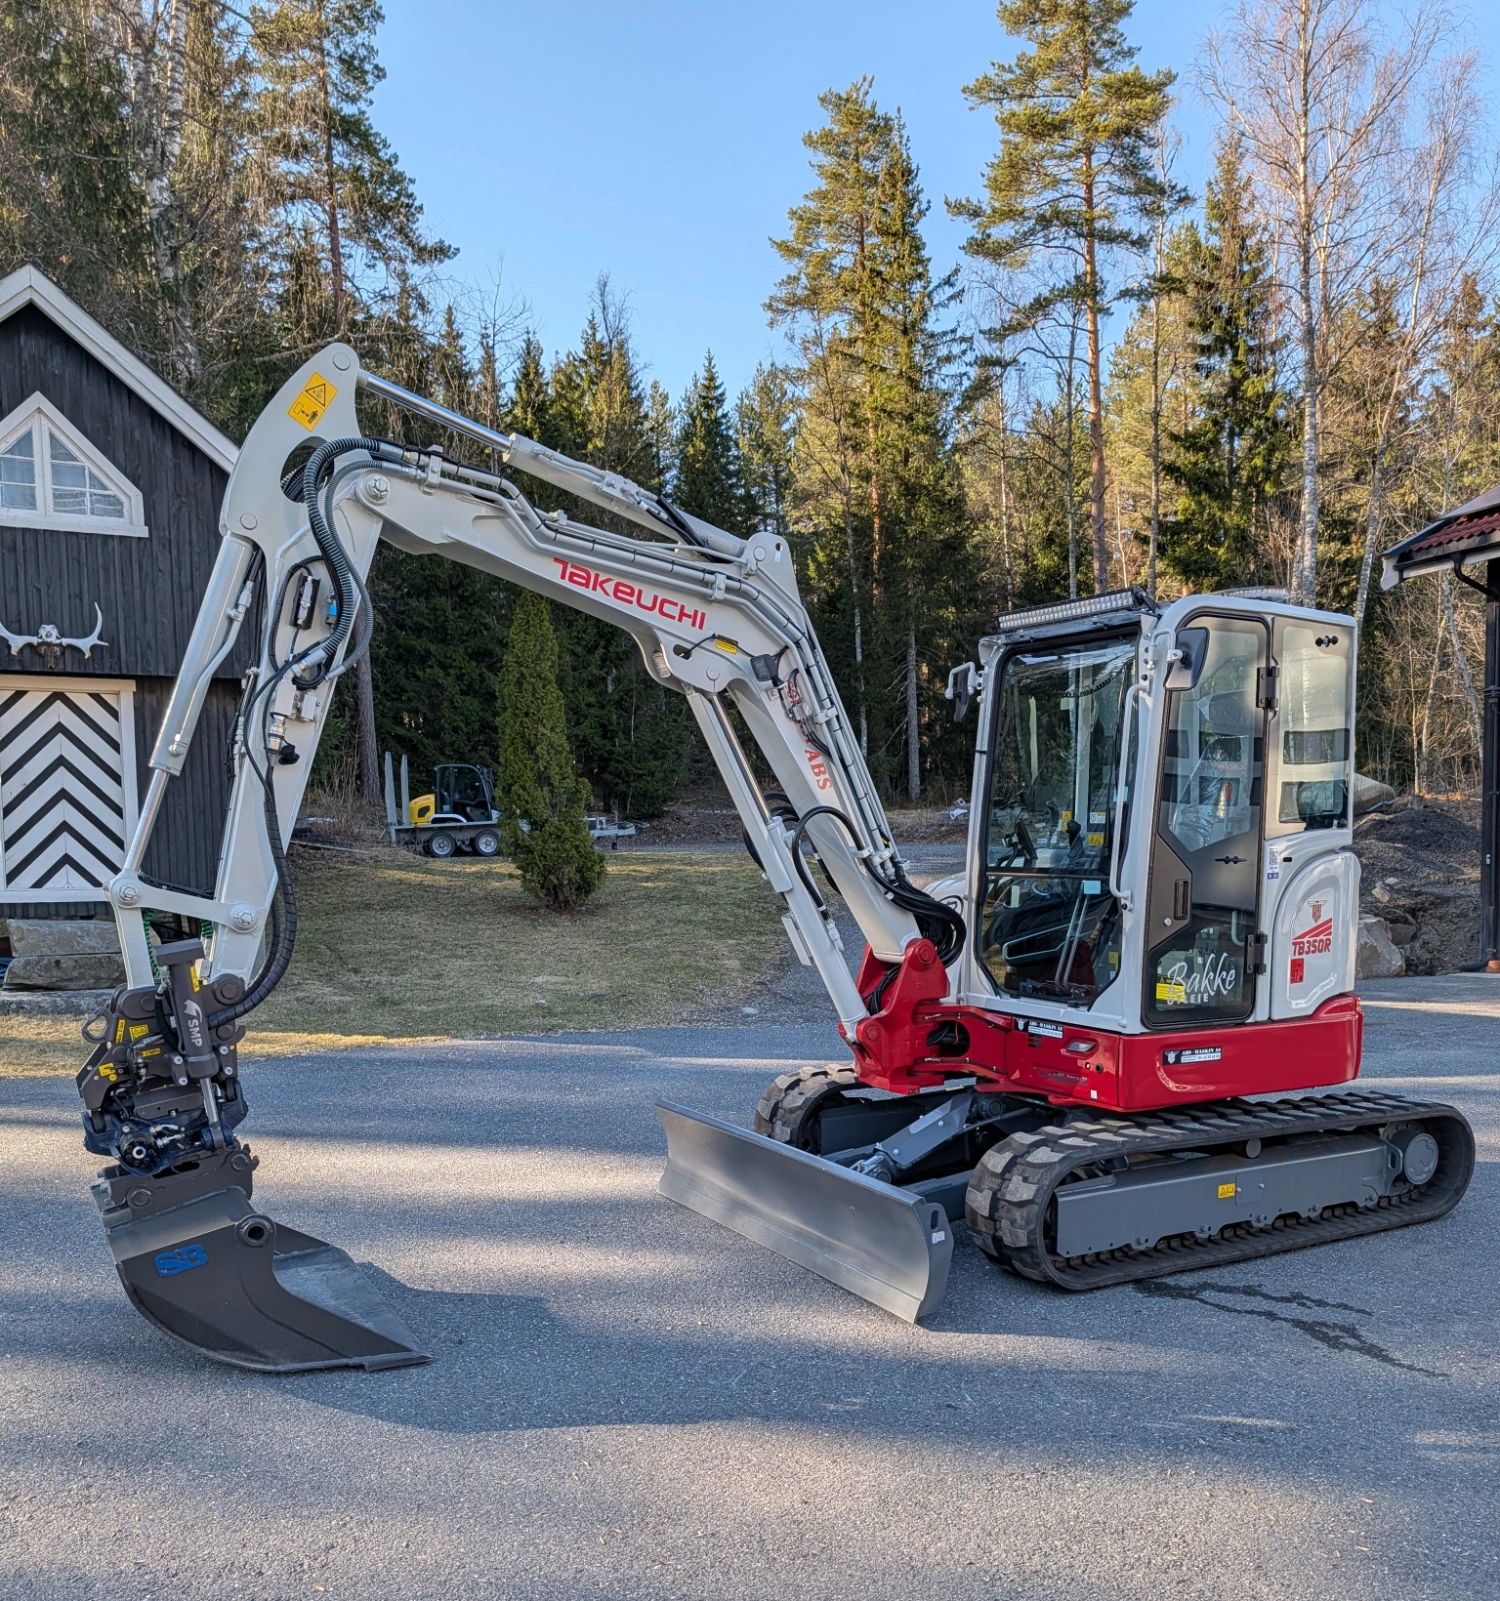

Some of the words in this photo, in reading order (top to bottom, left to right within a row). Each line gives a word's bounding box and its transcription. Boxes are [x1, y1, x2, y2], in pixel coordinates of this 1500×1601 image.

[804, 749, 833, 791] ABS
[1291, 937, 1332, 957] TB350R
[1167, 952, 1236, 996] Bakke
[187, 1019, 203, 1047] SMP
[154, 1244, 208, 1277] SB
